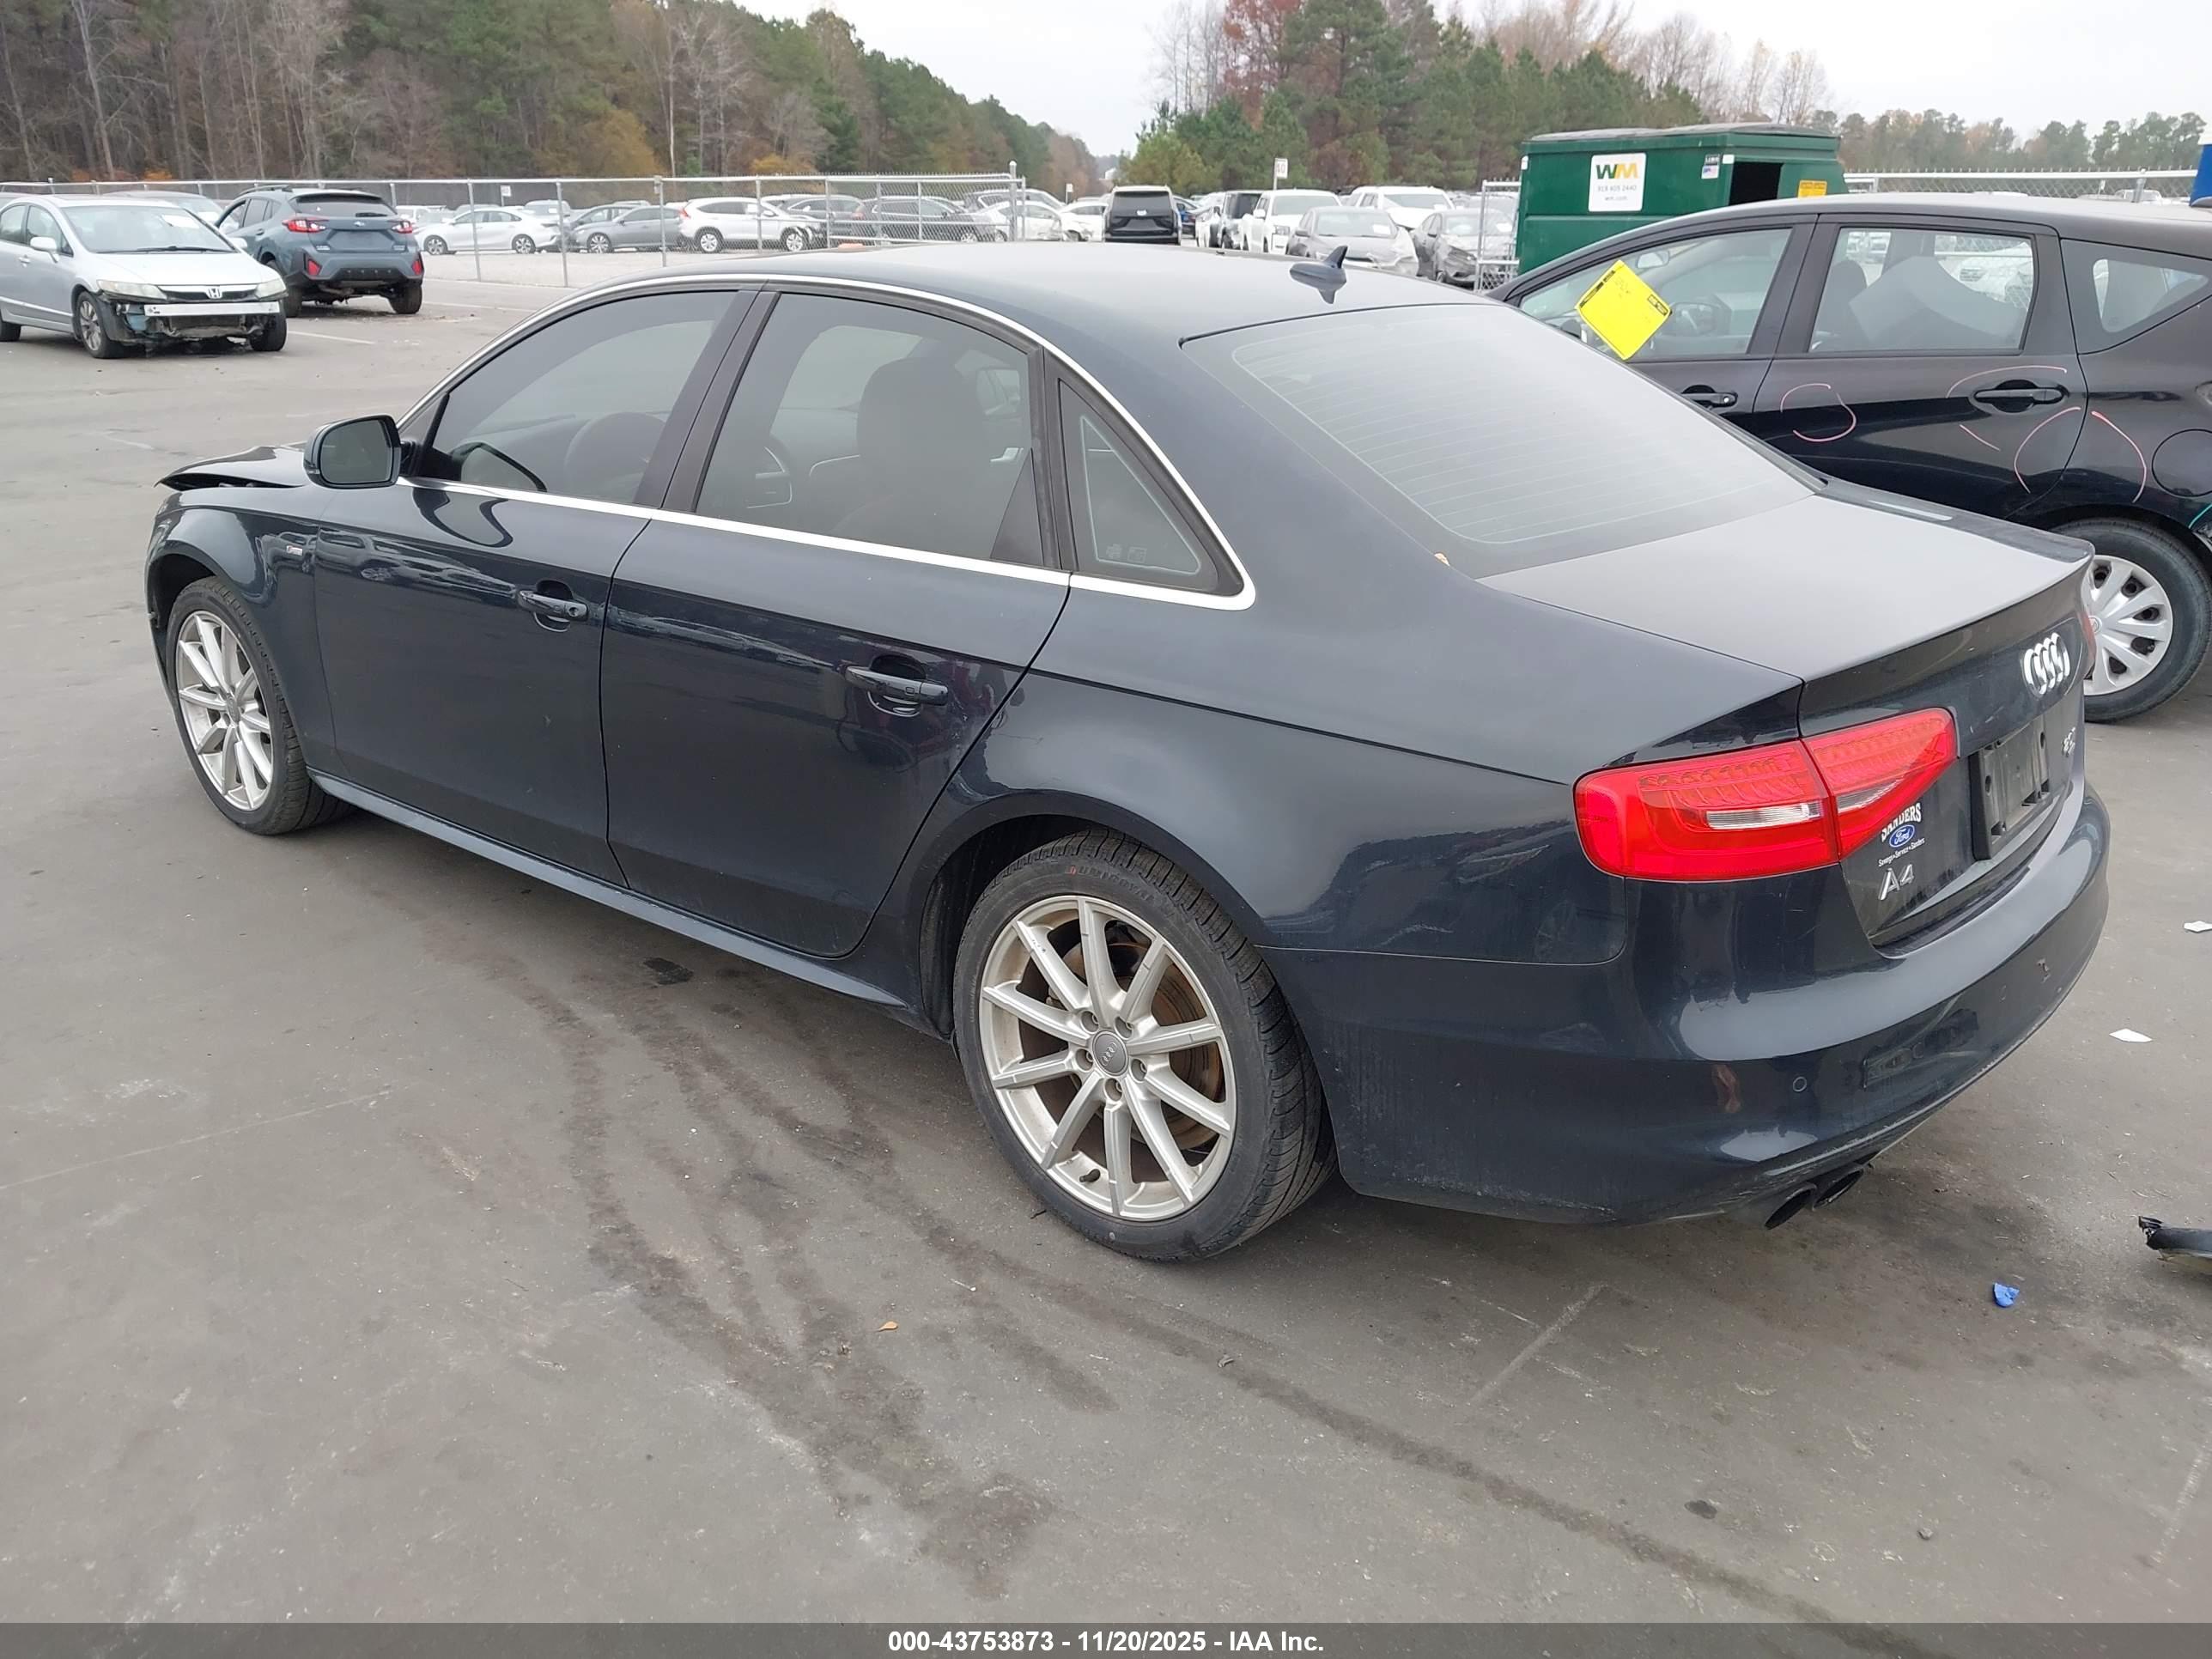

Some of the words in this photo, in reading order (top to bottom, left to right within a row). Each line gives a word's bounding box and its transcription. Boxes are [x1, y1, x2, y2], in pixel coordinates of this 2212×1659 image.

[1596, 163, 1639, 179] WM
[1893, 827, 1911, 845] Ford
[1878, 864, 1915, 901] A4
